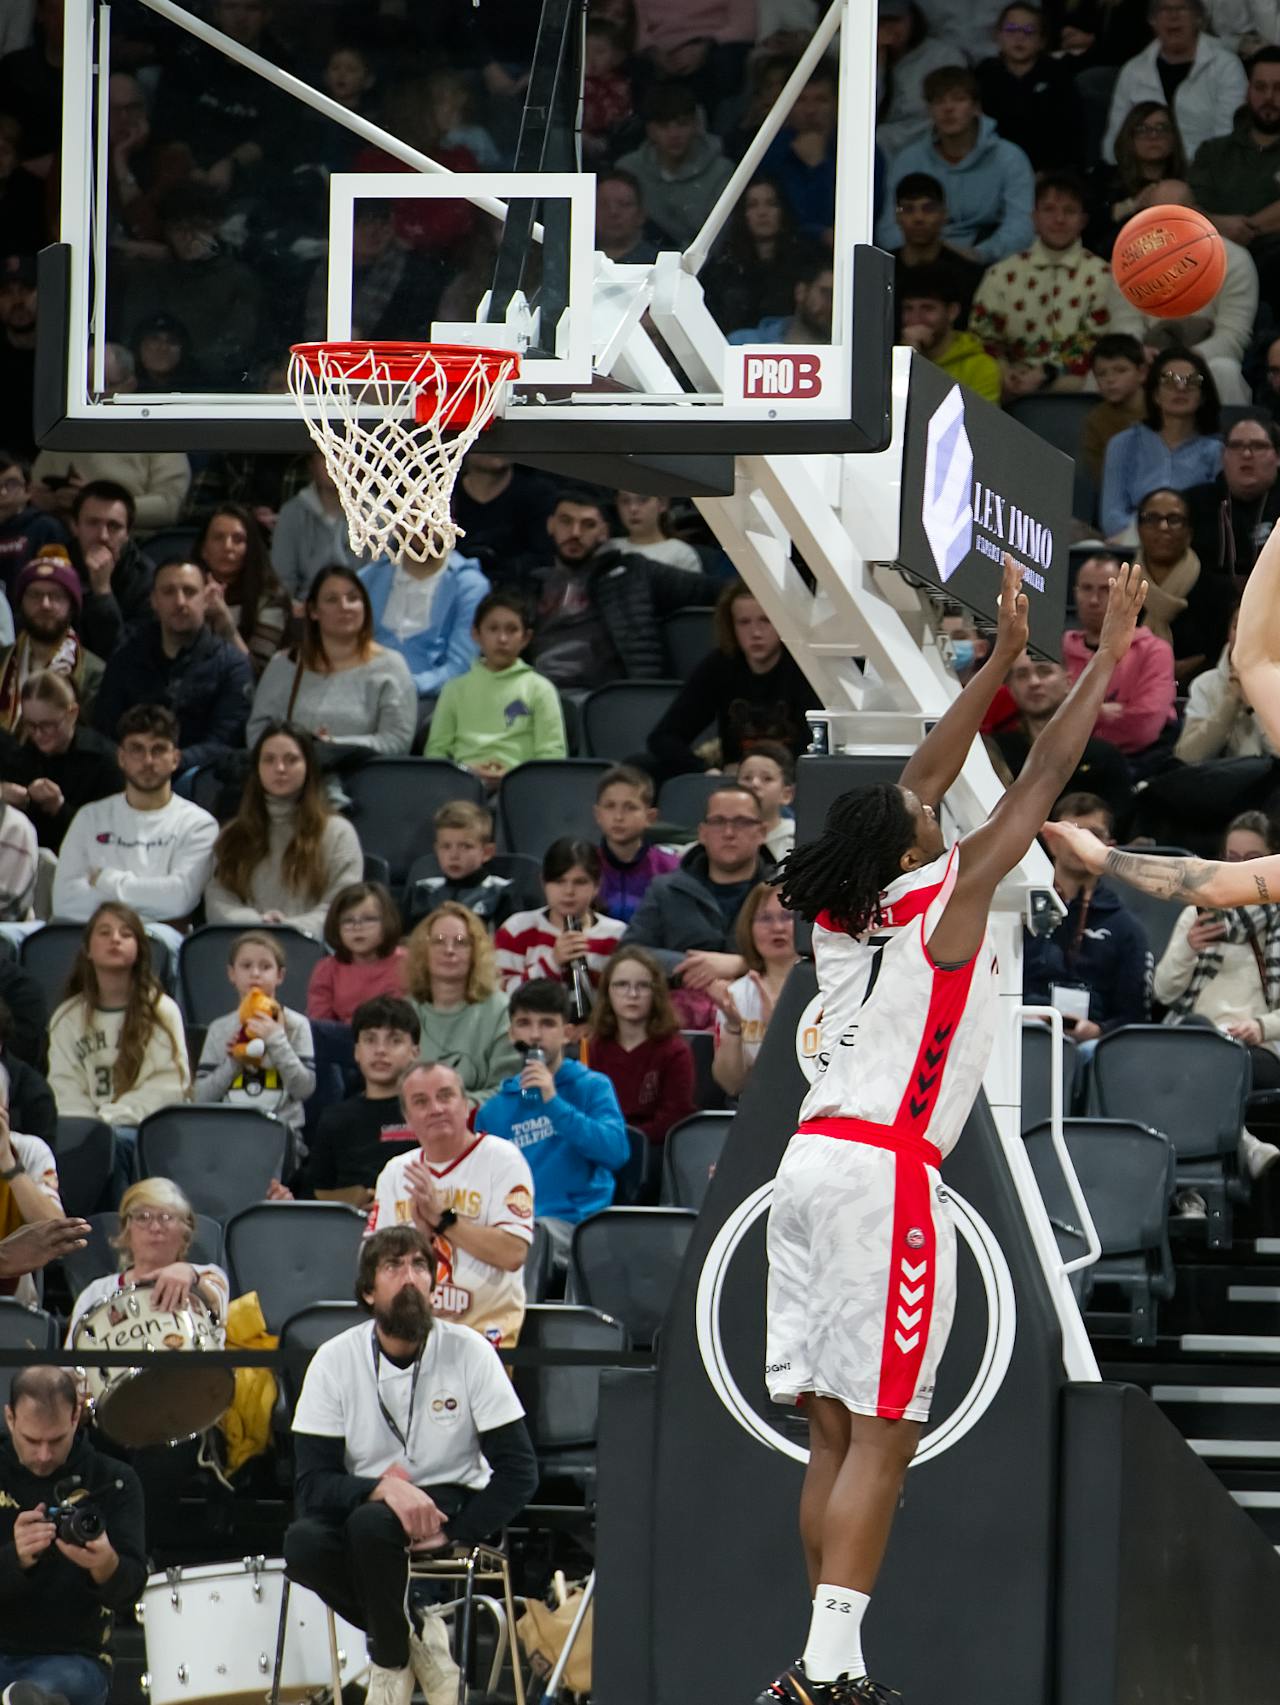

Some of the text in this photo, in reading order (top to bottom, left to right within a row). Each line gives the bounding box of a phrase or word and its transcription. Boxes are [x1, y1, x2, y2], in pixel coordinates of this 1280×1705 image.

[973, 481, 1005, 539] LEX
[1008, 505, 1053, 570] IMMO
[825, 1598, 852, 1614] 23
